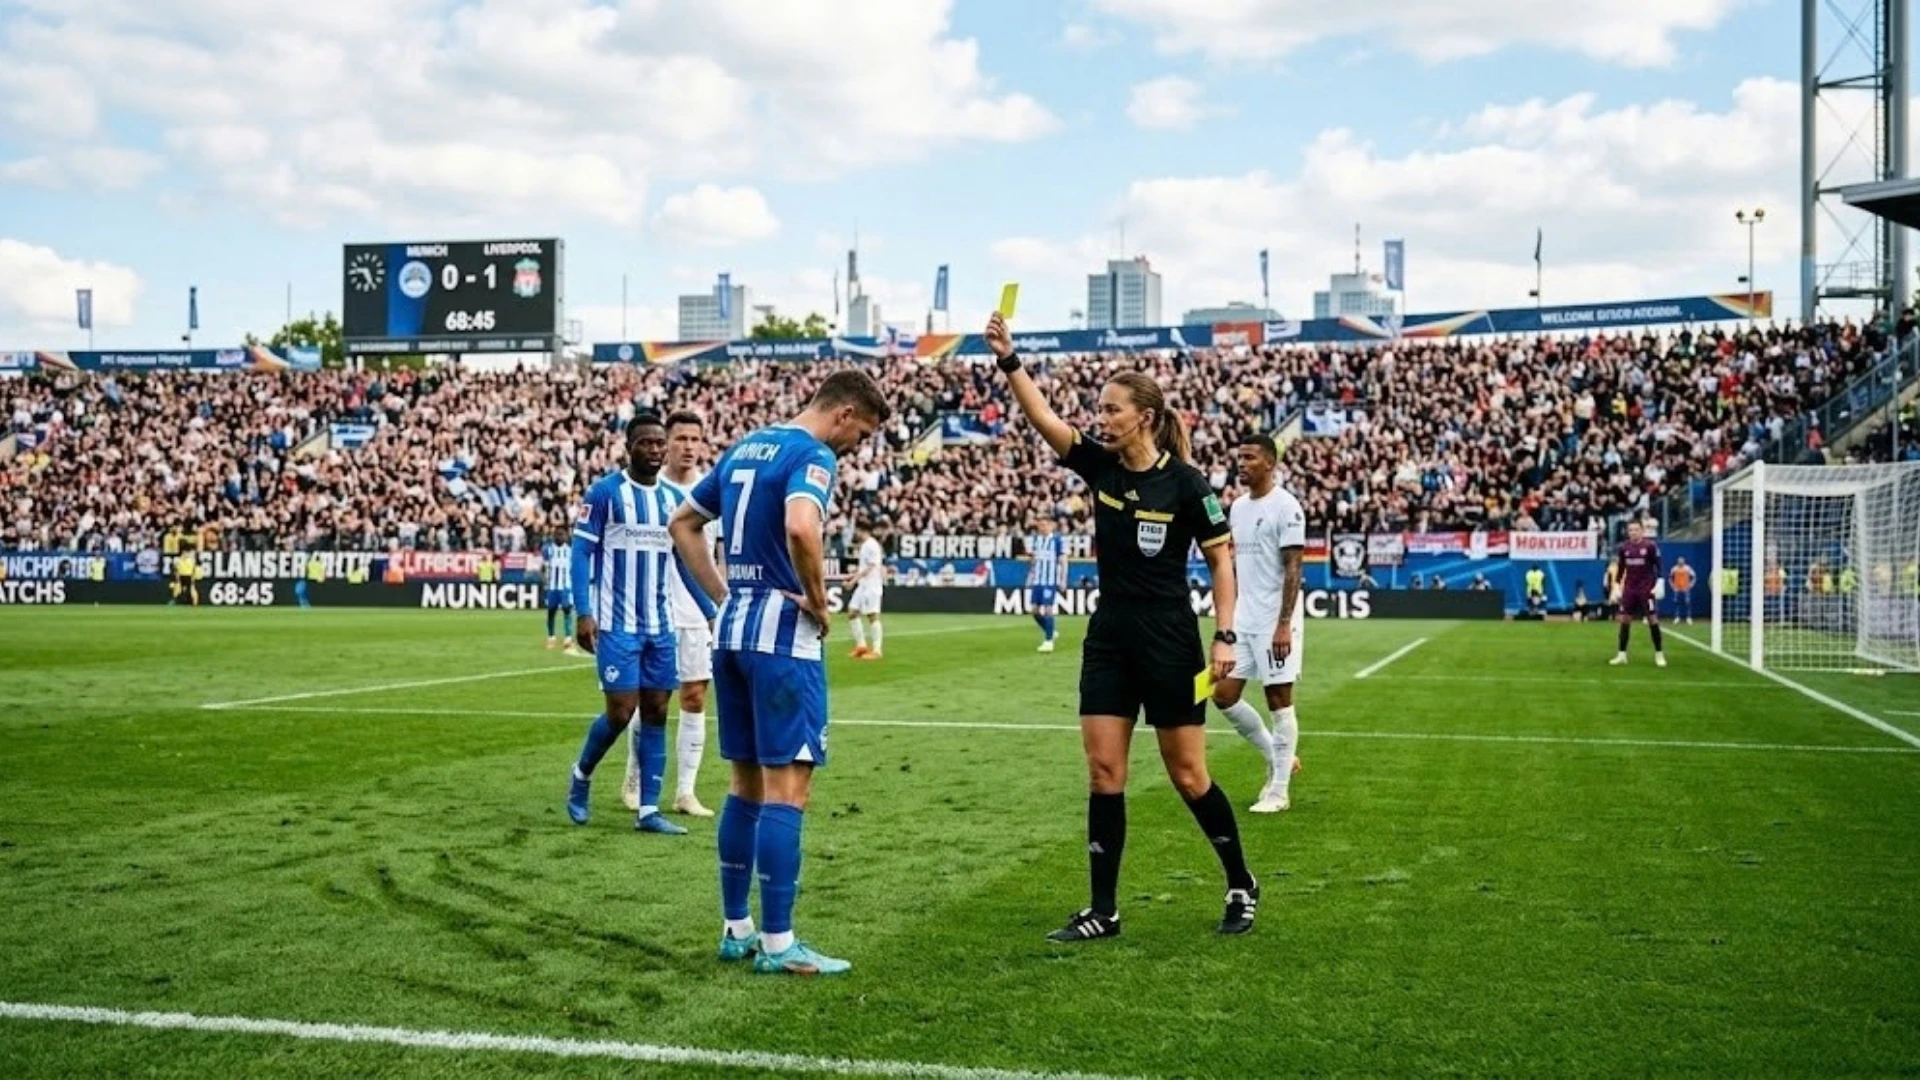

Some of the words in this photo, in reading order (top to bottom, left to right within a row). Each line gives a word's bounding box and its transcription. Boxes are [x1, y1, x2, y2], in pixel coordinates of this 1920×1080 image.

[441, 264, 458, 290] 0
[484, 263, 497, 290] 1
[445, 310, 495, 331] 68:45
[730, 468, 756, 555] 7
[210, 582, 274, 605] 68:45
[422, 583, 539, 609] MUNICH
